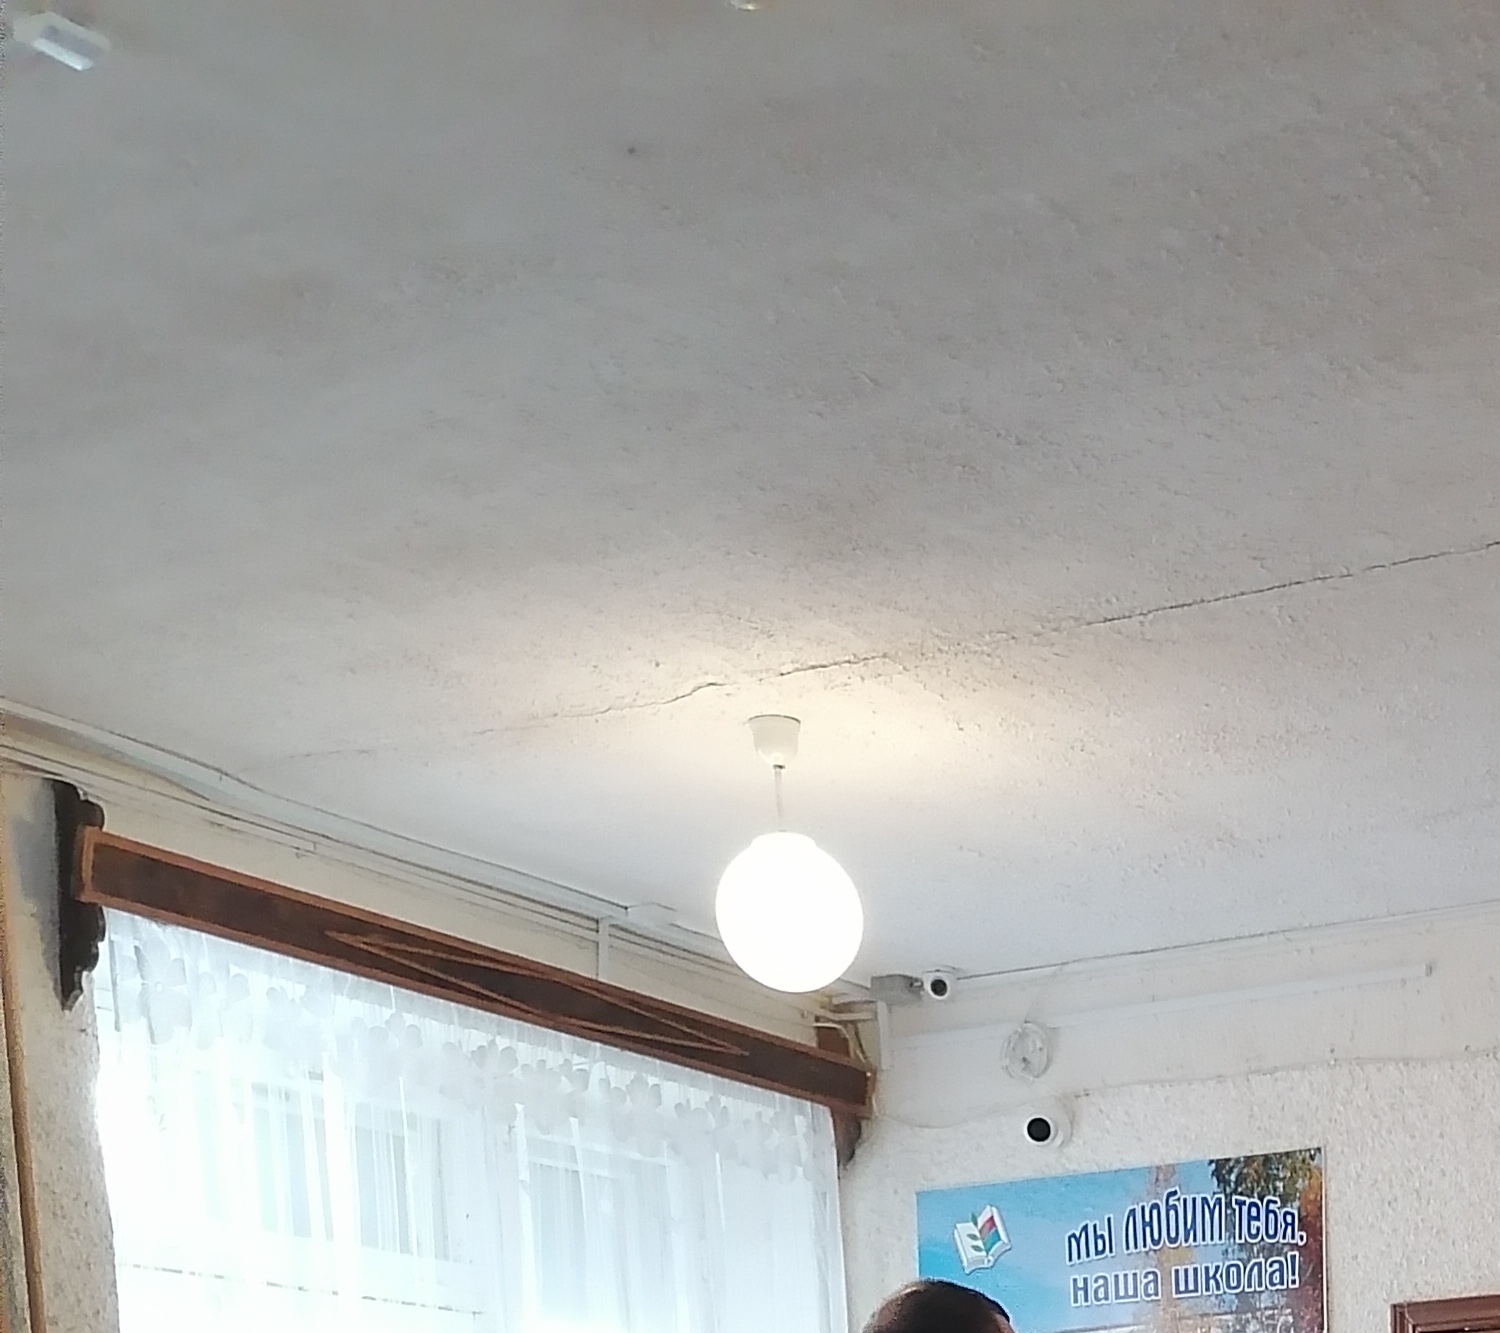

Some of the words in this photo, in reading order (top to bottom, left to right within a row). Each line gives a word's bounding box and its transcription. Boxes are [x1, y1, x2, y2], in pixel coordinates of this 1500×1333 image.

[1123, 1188, 1226, 1254] любим
[1232, 1196, 1307, 1246] тебя,
[1070, 1268, 1162, 1307] наша
[1172, 1251, 1300, 1299] школа!
